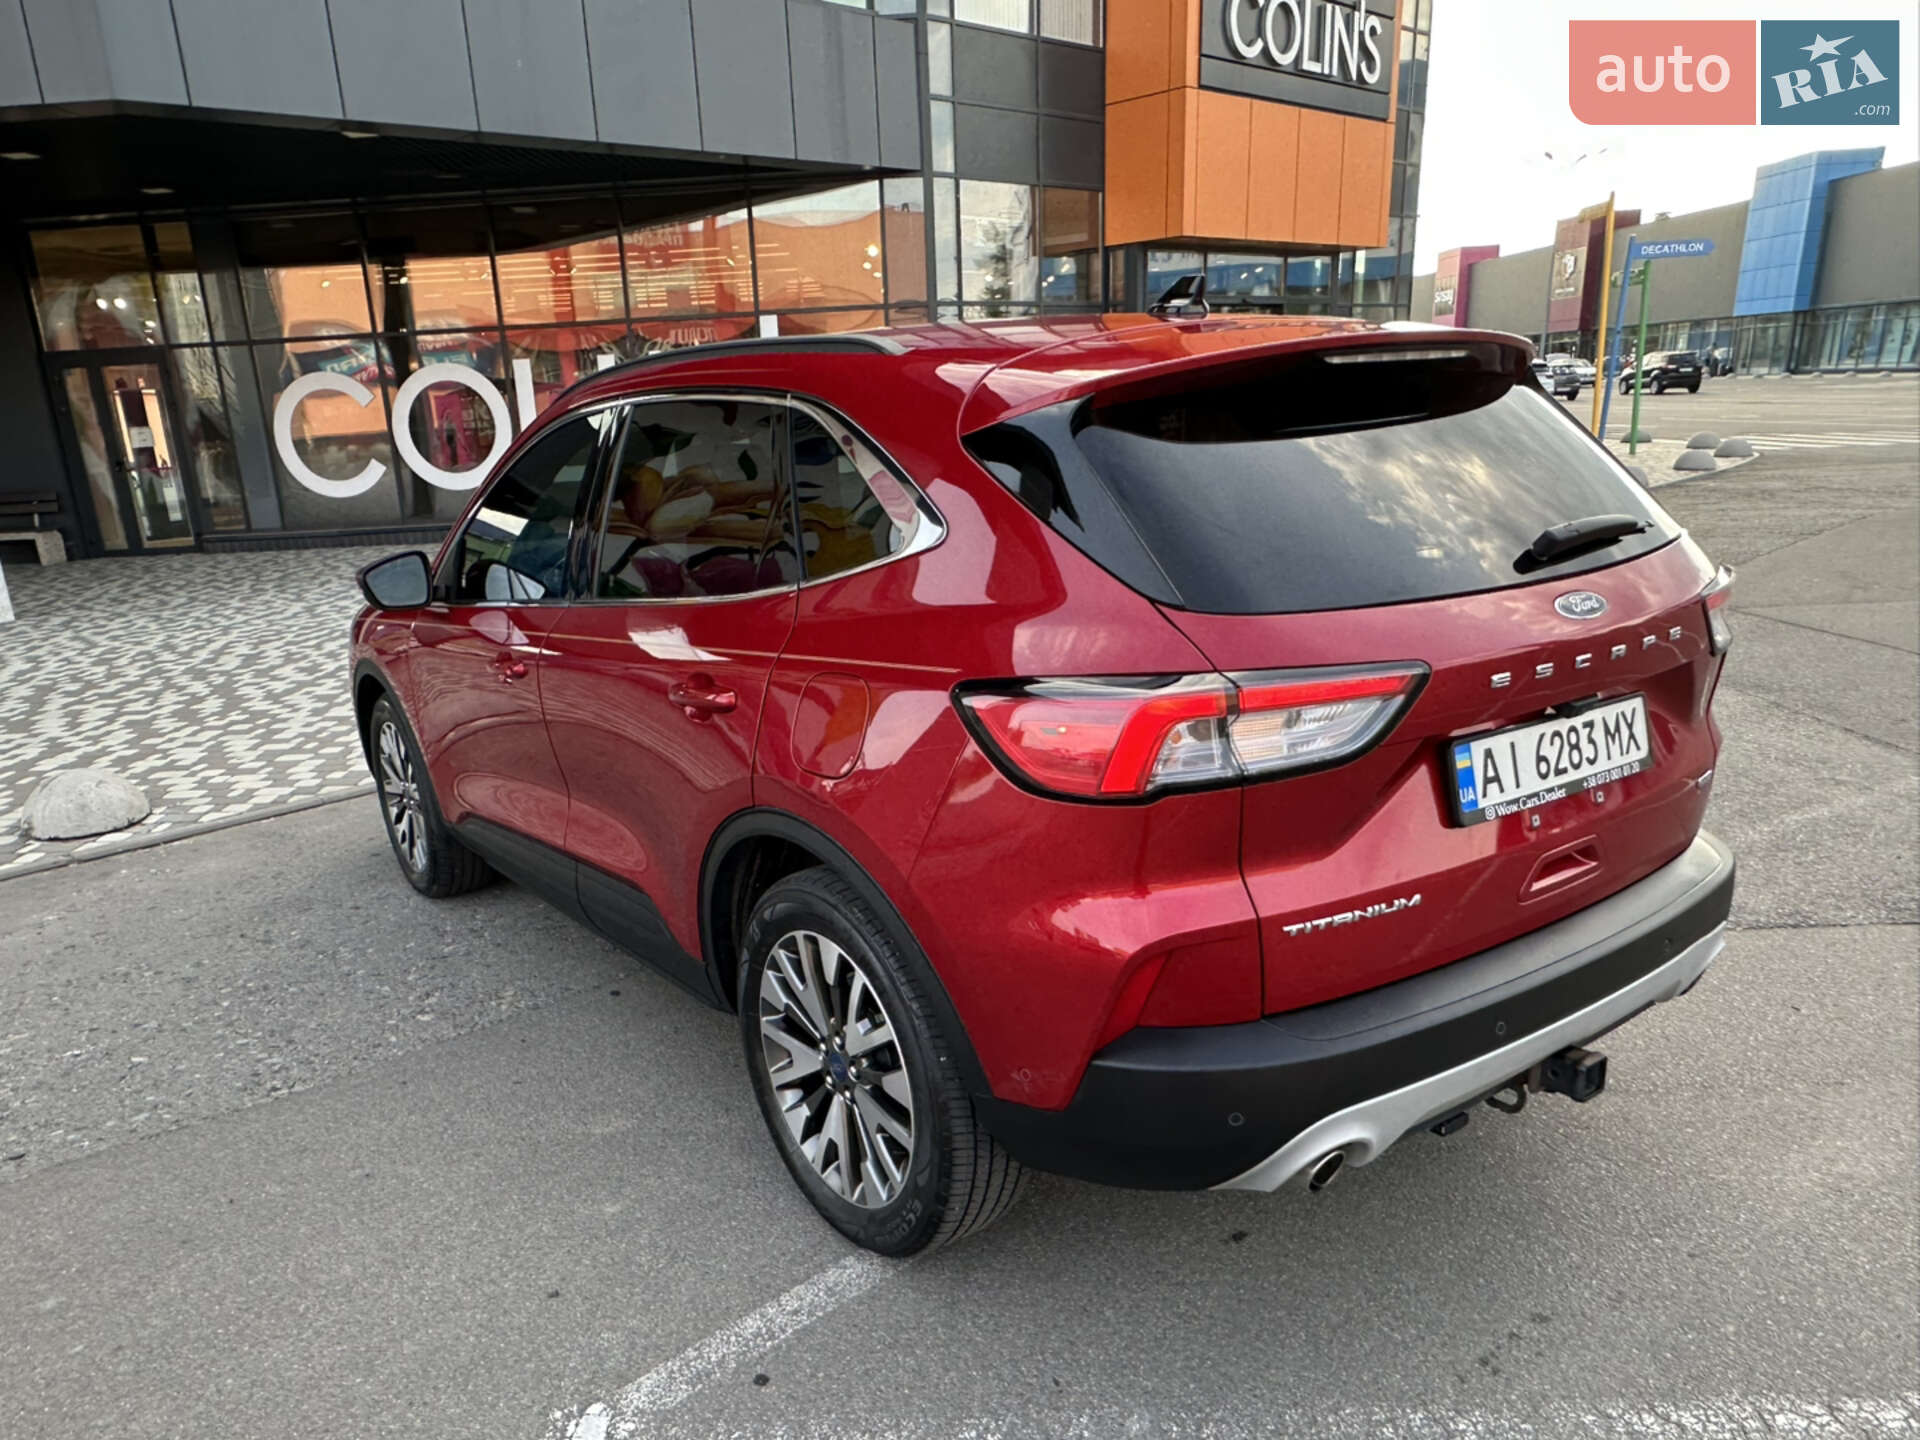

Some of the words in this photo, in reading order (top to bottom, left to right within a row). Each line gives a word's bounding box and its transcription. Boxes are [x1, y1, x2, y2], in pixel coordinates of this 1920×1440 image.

[1640, 242, 1705, 255] DECATHLON
[1567, 594, 1600, 612] Ford
[1490, 626, 1681, 688] ESCAPE
[1482, 741, 1520, 799] AI
[1535, 719, 1599, 780] 6283
[1602, 707, 1641, 761] MX
[1459, 787, 1476, 803] UA
[1282, 893, 1421, 936] TITANIUM
